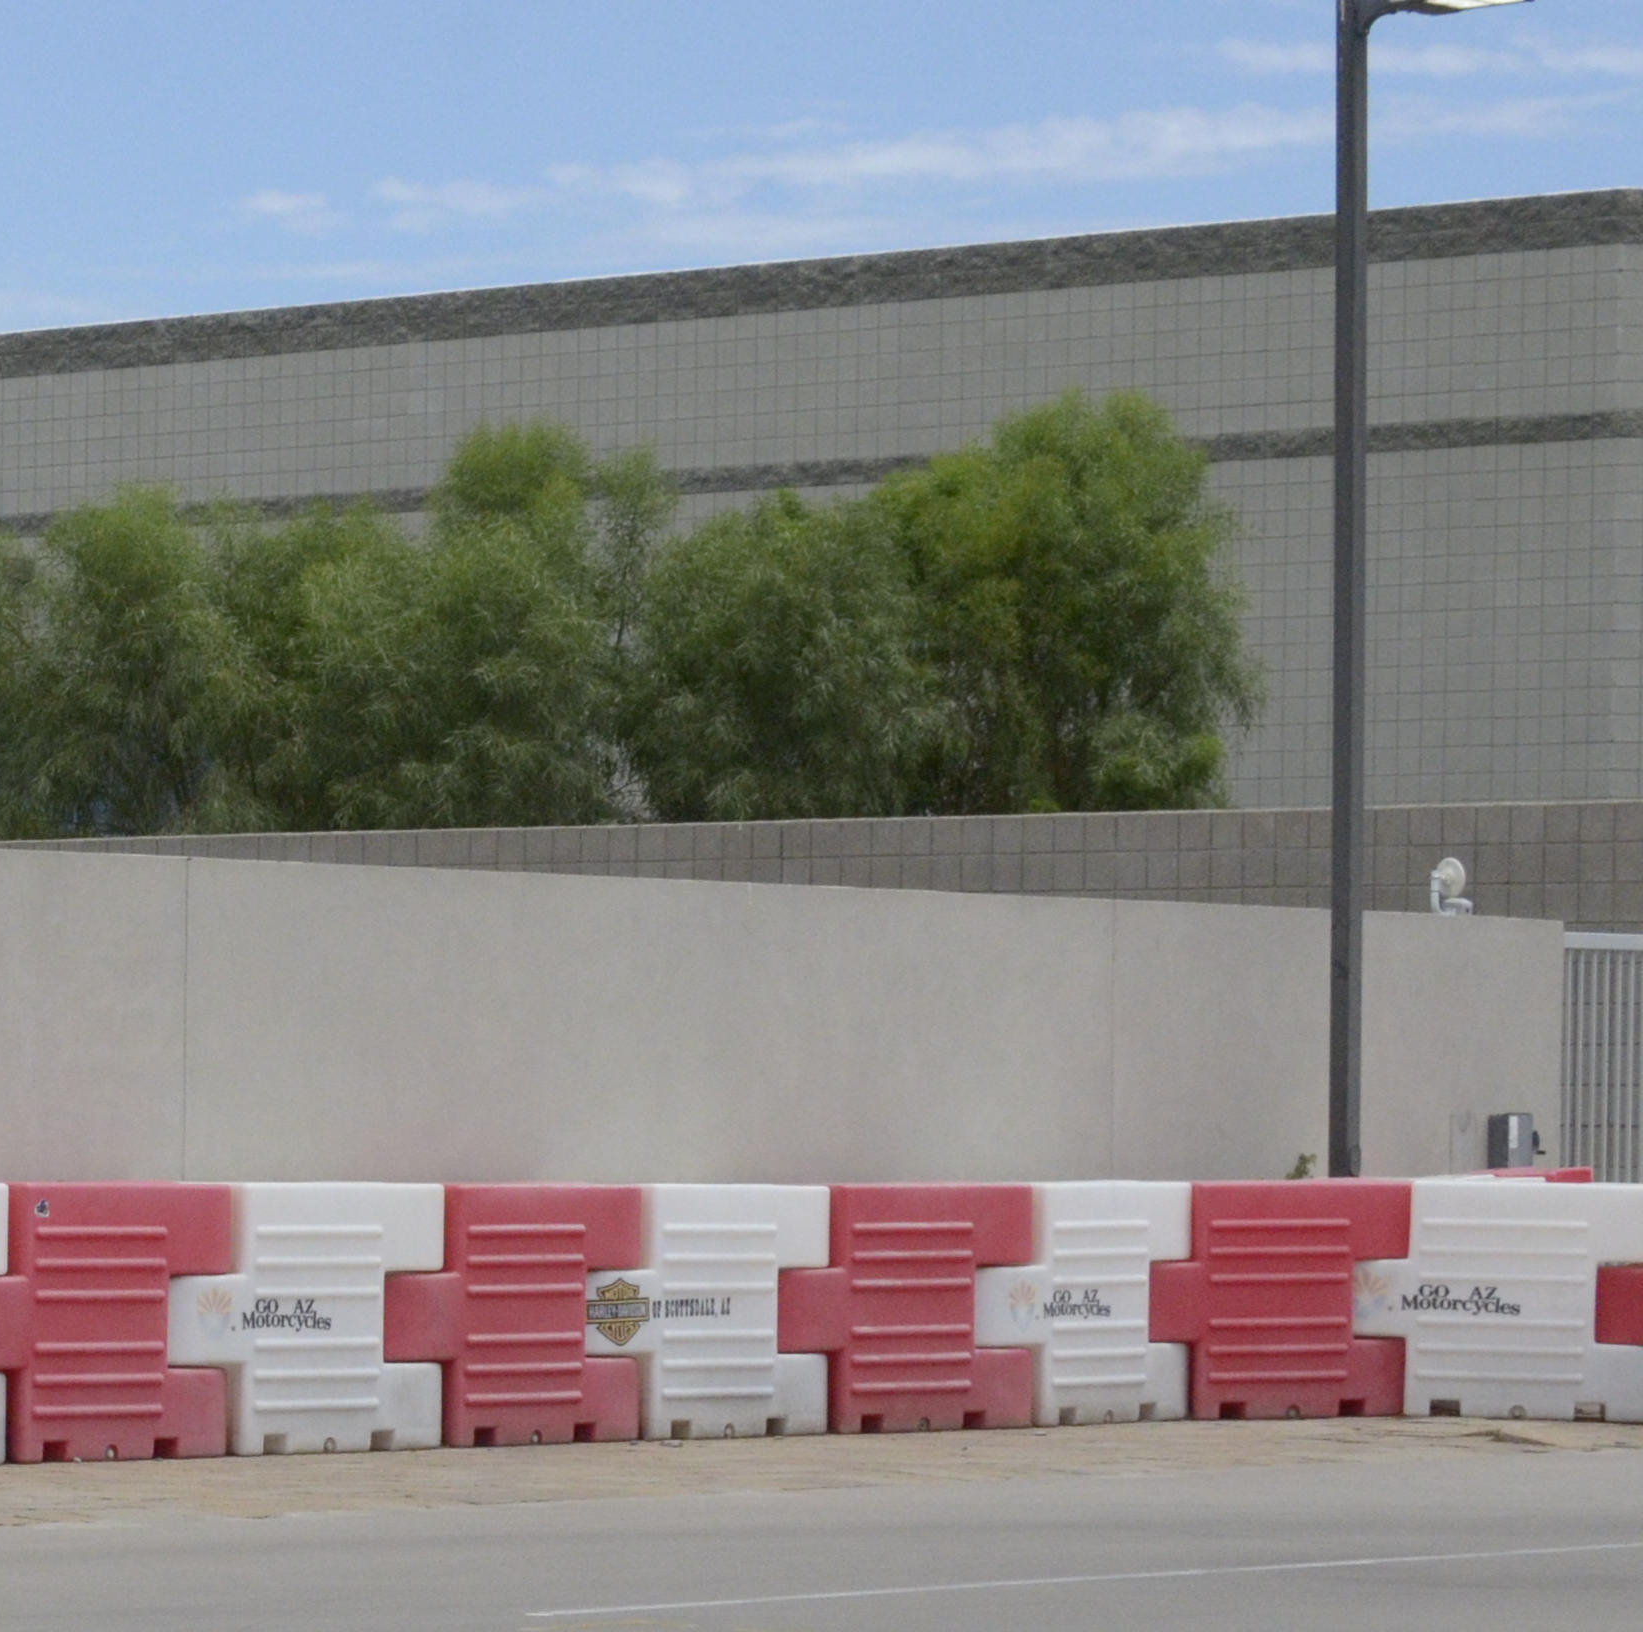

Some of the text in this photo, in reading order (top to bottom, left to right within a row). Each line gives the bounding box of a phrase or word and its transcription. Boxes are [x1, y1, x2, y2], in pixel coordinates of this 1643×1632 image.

[1419, 1284, 1497, 1300] GO AZ
[255, 1299, 315, 1314] GO AZ
[1401, 1294, 1521, 1315] Motorcycles
[242, 1310, 332, 1332] Motorcycles
